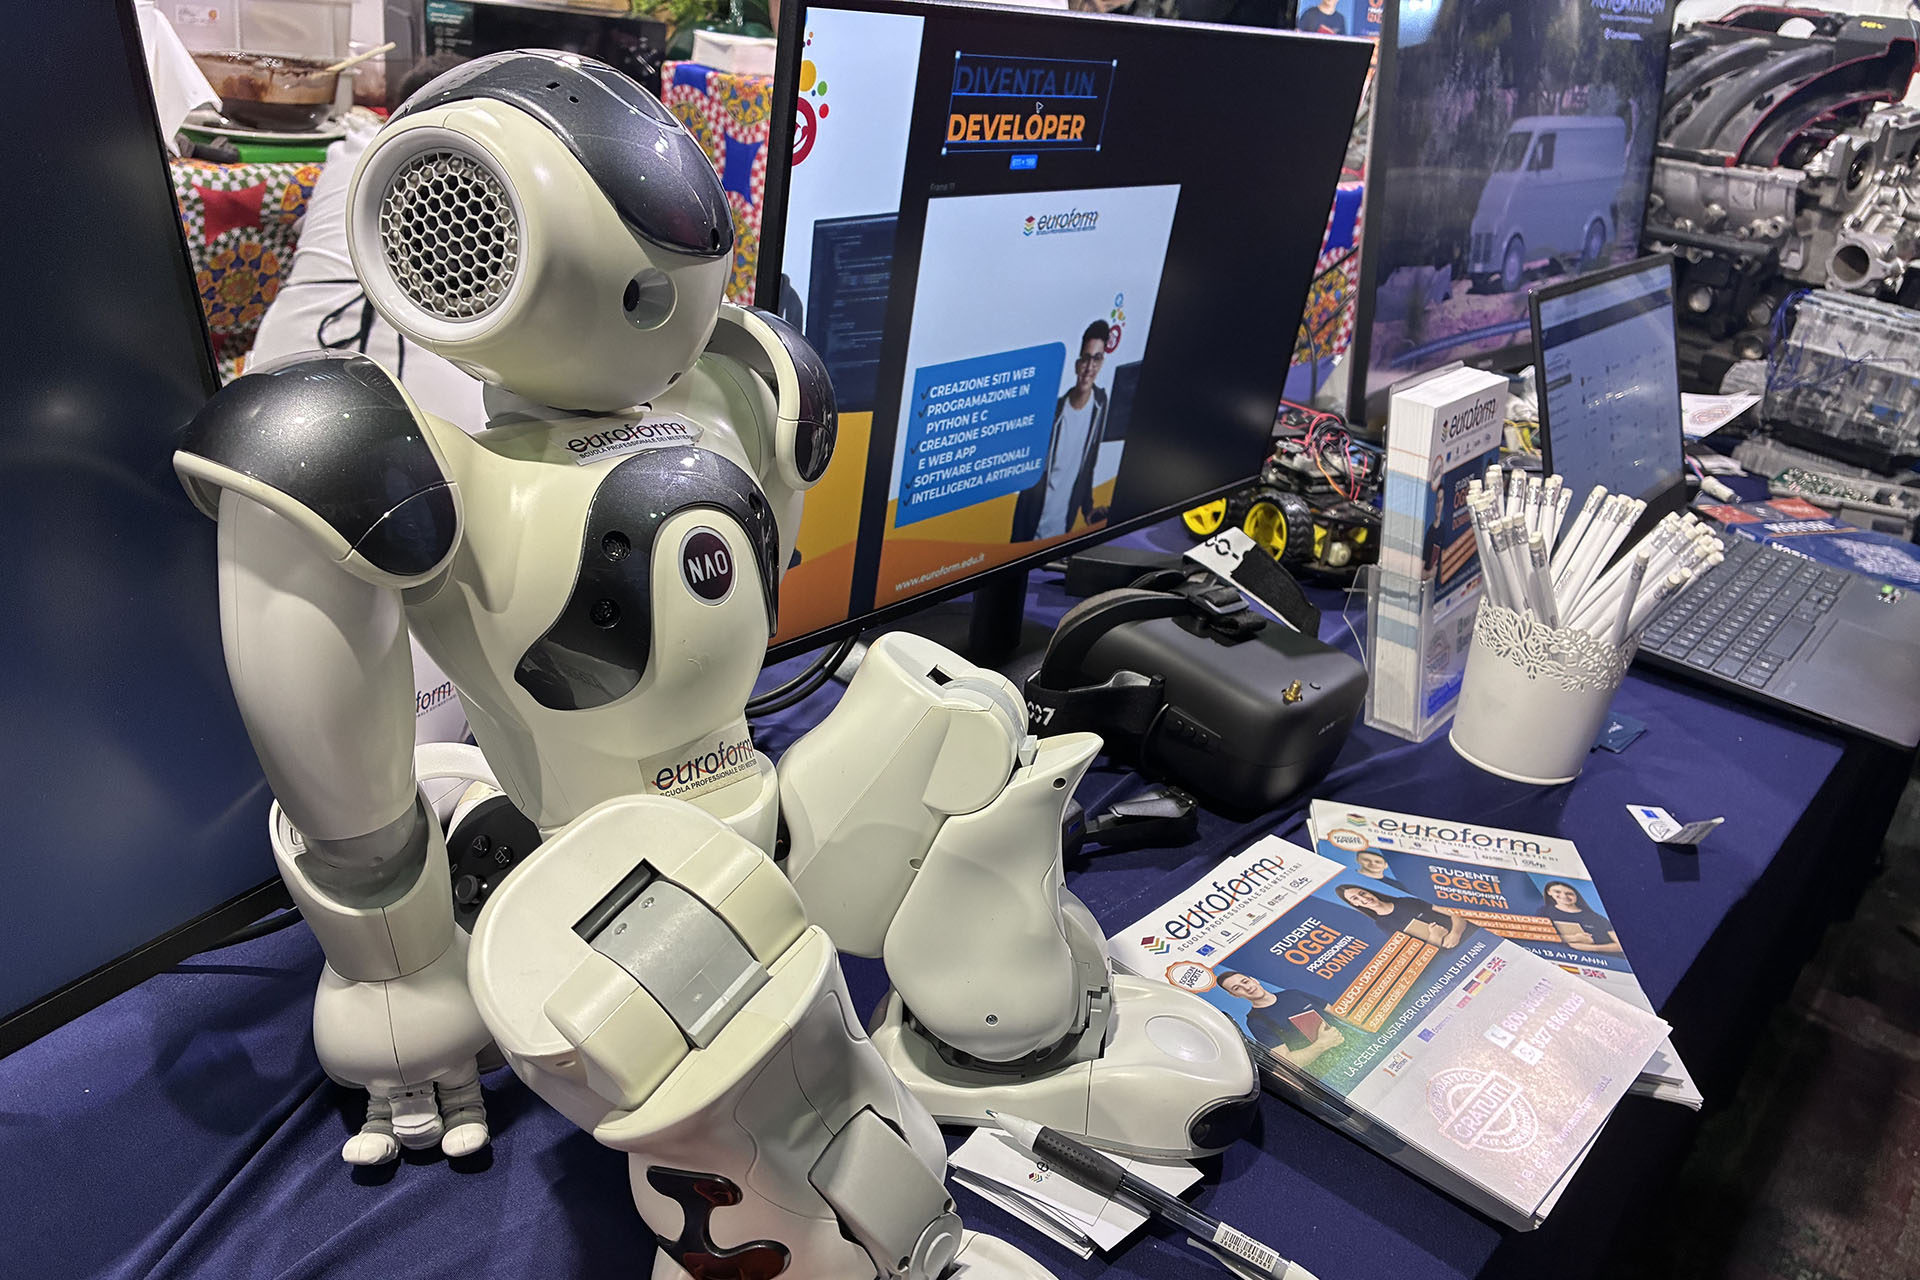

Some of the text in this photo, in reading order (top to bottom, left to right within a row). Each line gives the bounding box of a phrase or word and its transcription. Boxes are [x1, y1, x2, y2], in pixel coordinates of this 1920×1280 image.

[954, 66, 1097, 97] DIVENTA UN
[947, 113, 1086, 141] DEVELOPER
[1037, 208, 1099, 230] euroform
[930, 366, 1036, 398] CREAZIONE SITI WEB
[927, 384, 1030, 417] PROGRAMAZIONE IN
[919, 414, 1036, 453] CREAZIONE SOFTWARE
[926, 409, 989, 434] PYTHON E C
[1449, 398, 1497, 438] euroform
[567, 421, 687, 453] euroform
[579, 448, 608, 460] SCUOLA
[607, 438, 656, 453] PROFESSIONALE
[914, 447, 1031, 488] SOFTWARE GESTIONALI
[918, 445, 977, 471] E WEB APP
[911, 458, 1042, 505] INTELLIGENZA ARTIFICIALE
[687, 549, 729, 584] NAO
[895, 552, 985, 591] www.euroform.edu.it
[653, 738, 755, 790] euroform
[691, 767, 738, 790] PROFESSIONALE
[1368, 828, 1406, 839] SCUOLA
[1376, 818, 1543, 855] euroform
[1429, 865, 1501, 883] STUDENTE
[1431, 873, 1501, 894] OGGI
[1165, 855, 1284, 940] euroform
[1177, 863, 1303, 952] SCUOLA PROFESSIONALE DEI MESTIERI
[1434, 884, 1507, 901] PROFESSIONISTA
[1436, 890, 1509, 910] DOMANI
[1269, 916, 1322, 956] STUDENTE
[1284, 924, 1342, 965] OGGI
[1306, 935, 1355, 973] PROFESSIONISTA
[1316, 939, 1370, 980] DOMANI
[1555, 951, 1566, 959] AI
[1581, 955, 1608, 966] ANNI
[1332, 984, 1364, 1015] QUALIFICA
[1358, 958, 1386, 983] DIPLOMA
[1344, 1064, 1358, 1078] LA
[1356, 1044, 1382, 1068] SCELTA
[1377, 1021, 1405, 1045] GIUSTA
[1398, 1006, 1417, 1024] PER
[1415, 981, 1444, 1008] GIOVANI
[1438, 971, 1454, 987] DAI
[1456, 959, 1466, 970] AI
[1468, 941, 1487, 957] ANNI
[1502, 1008, 1528, 1032] 800
[1453, 1081, 1512, 1139] GRATUITI
